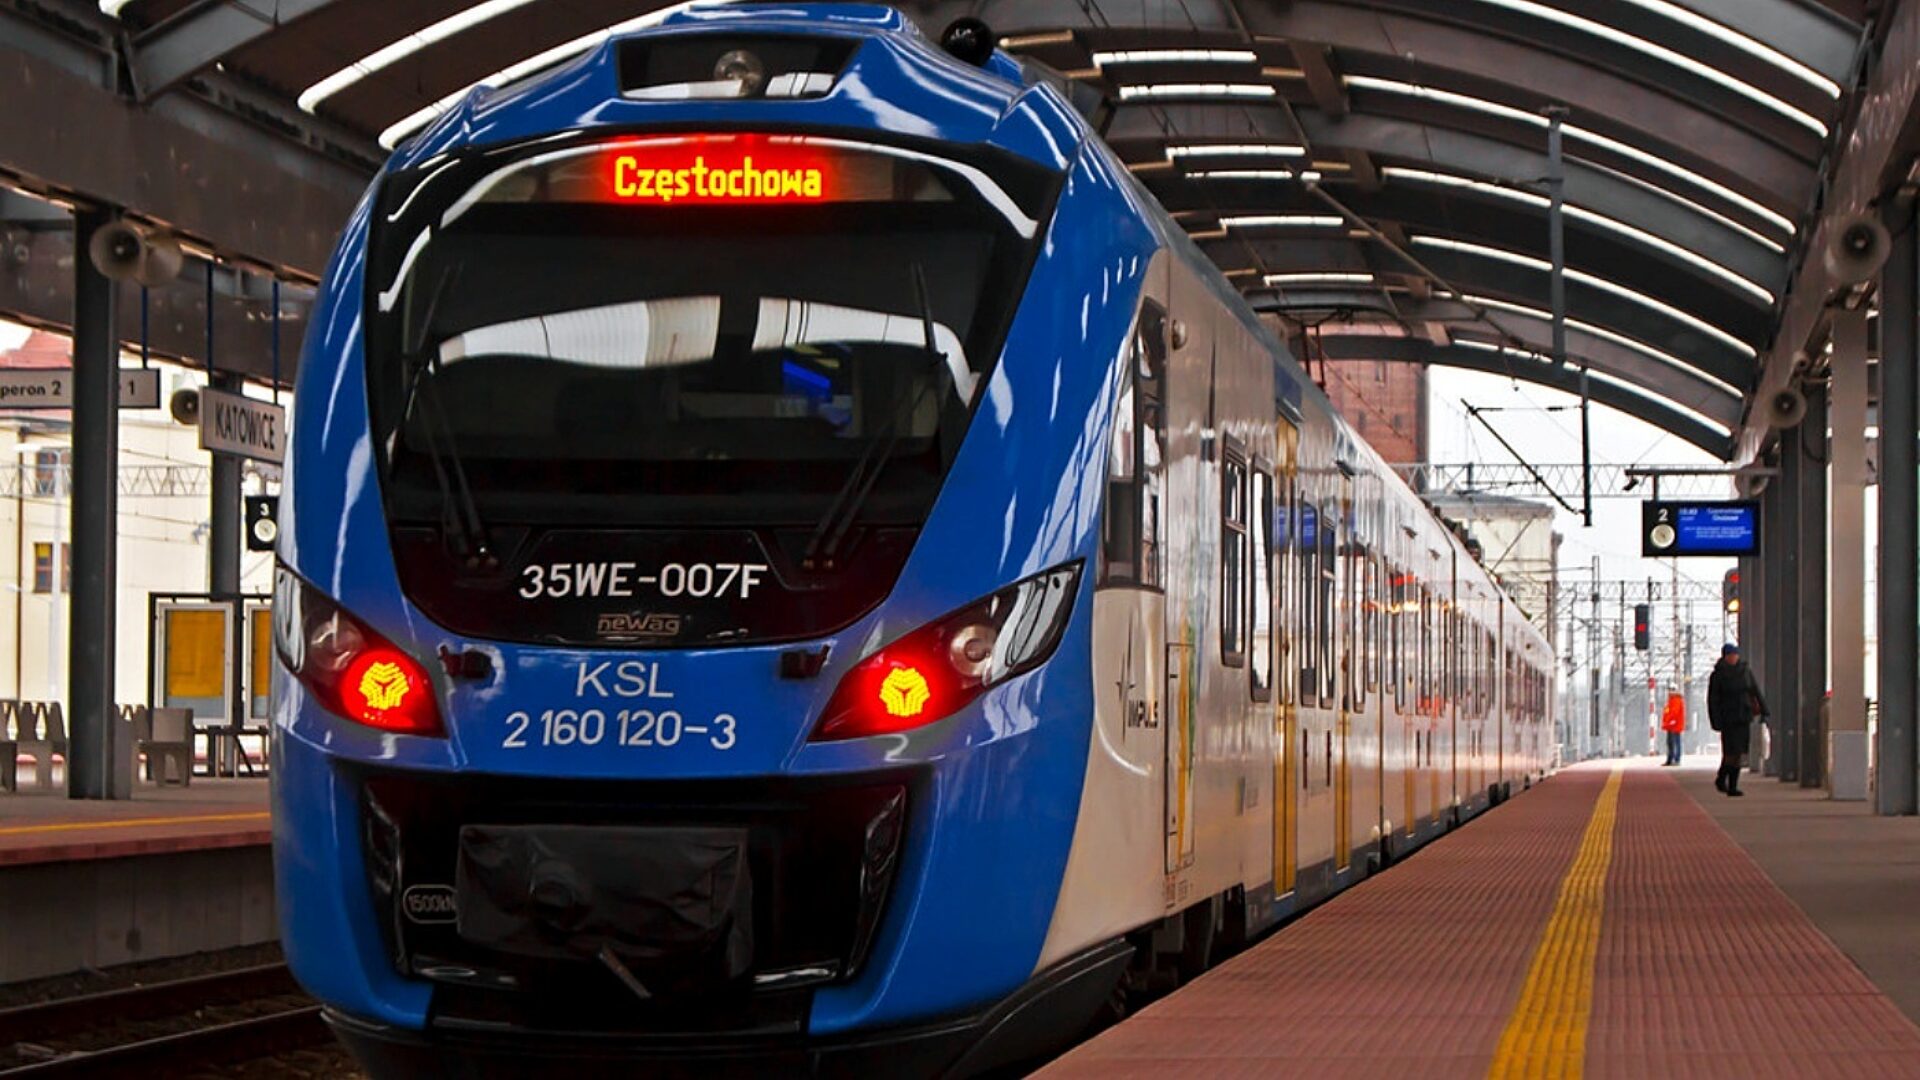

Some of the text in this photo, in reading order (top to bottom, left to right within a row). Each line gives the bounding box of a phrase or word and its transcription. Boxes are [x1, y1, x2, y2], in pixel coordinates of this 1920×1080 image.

[614, 156, 822, 202] Częstochowa
[0, 380, 135, 399] peron 2 1
[215, 403, 276, 450] KATOWICE
[259, 502, 270, 516] 3
[1658, 508, 1669, 521] 2
[519, 562, 768, 599] 35WE-007F
[576, 660, 674, 698] KSL
[502, 709, 737, 750] 2 160 120-3
